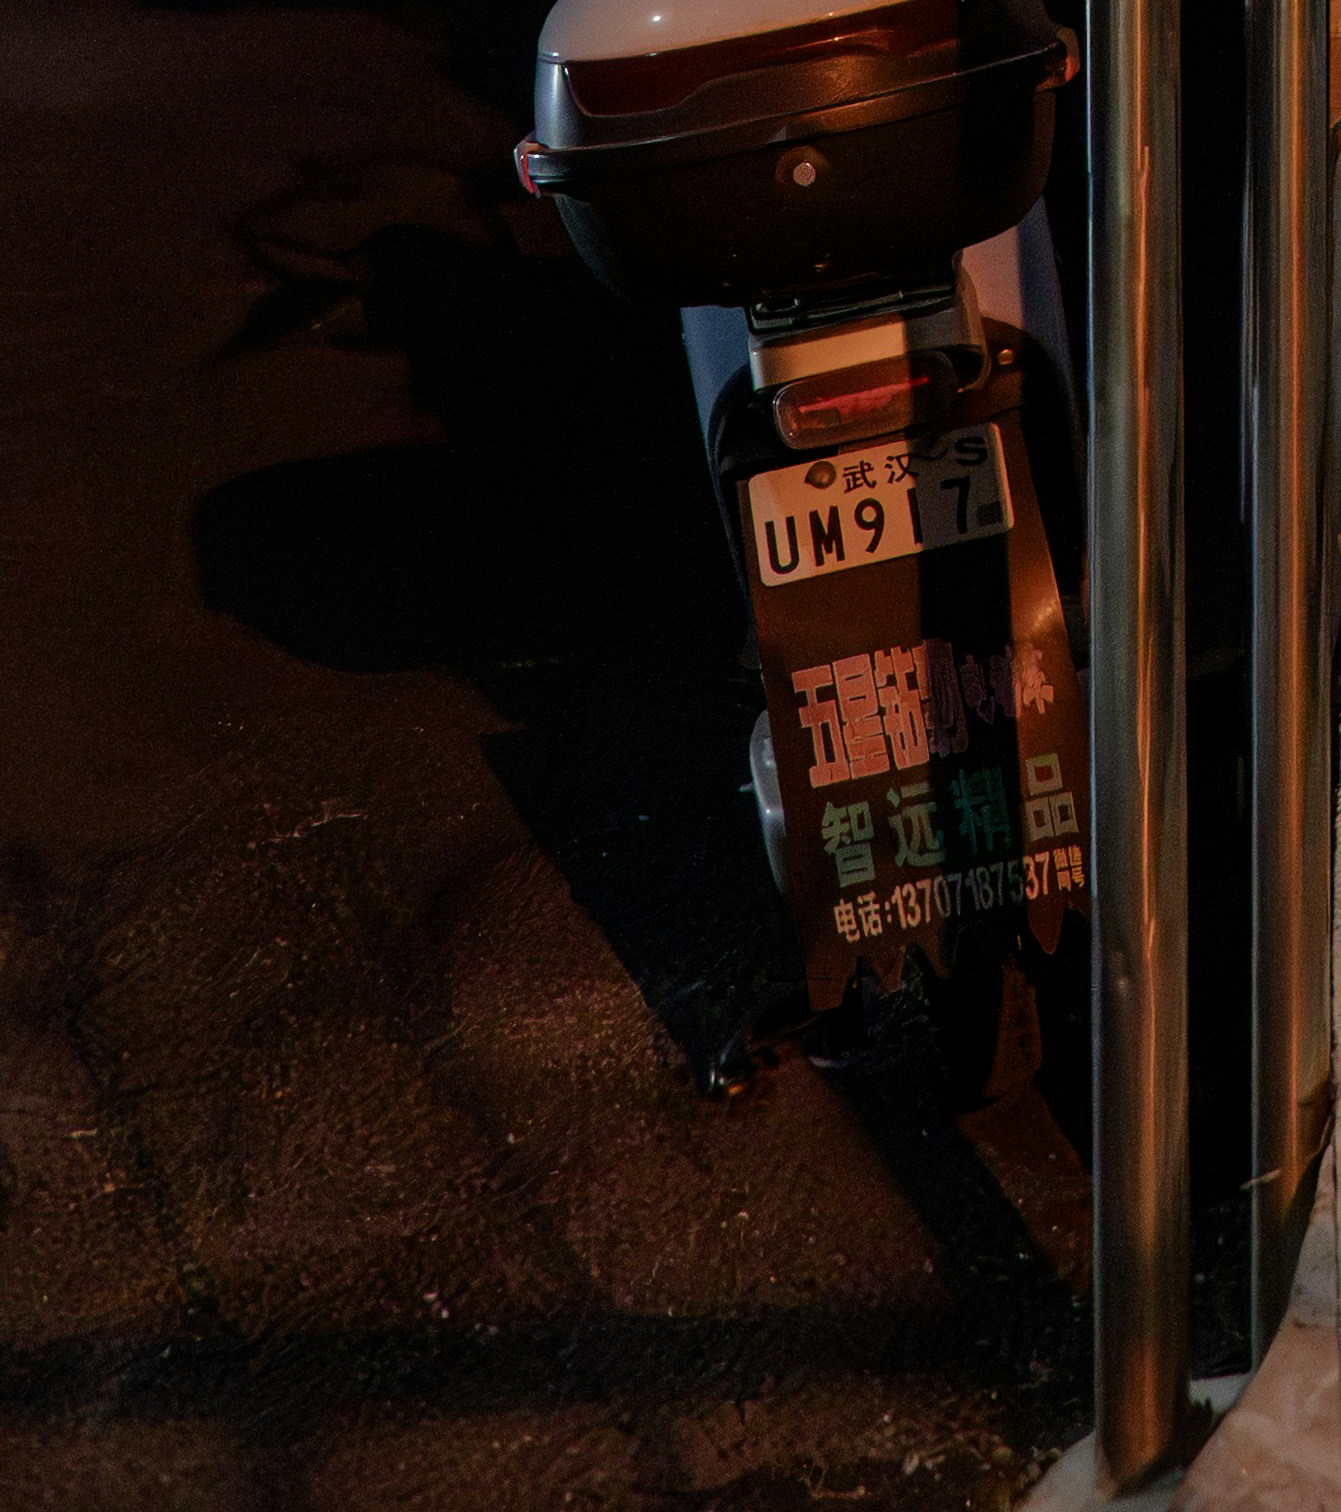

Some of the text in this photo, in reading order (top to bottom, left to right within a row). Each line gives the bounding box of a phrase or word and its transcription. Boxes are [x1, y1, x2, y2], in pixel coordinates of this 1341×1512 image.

[841, 436, 988, 494] 武汉 S
[821, 752, 1080, 889] 智远精品
